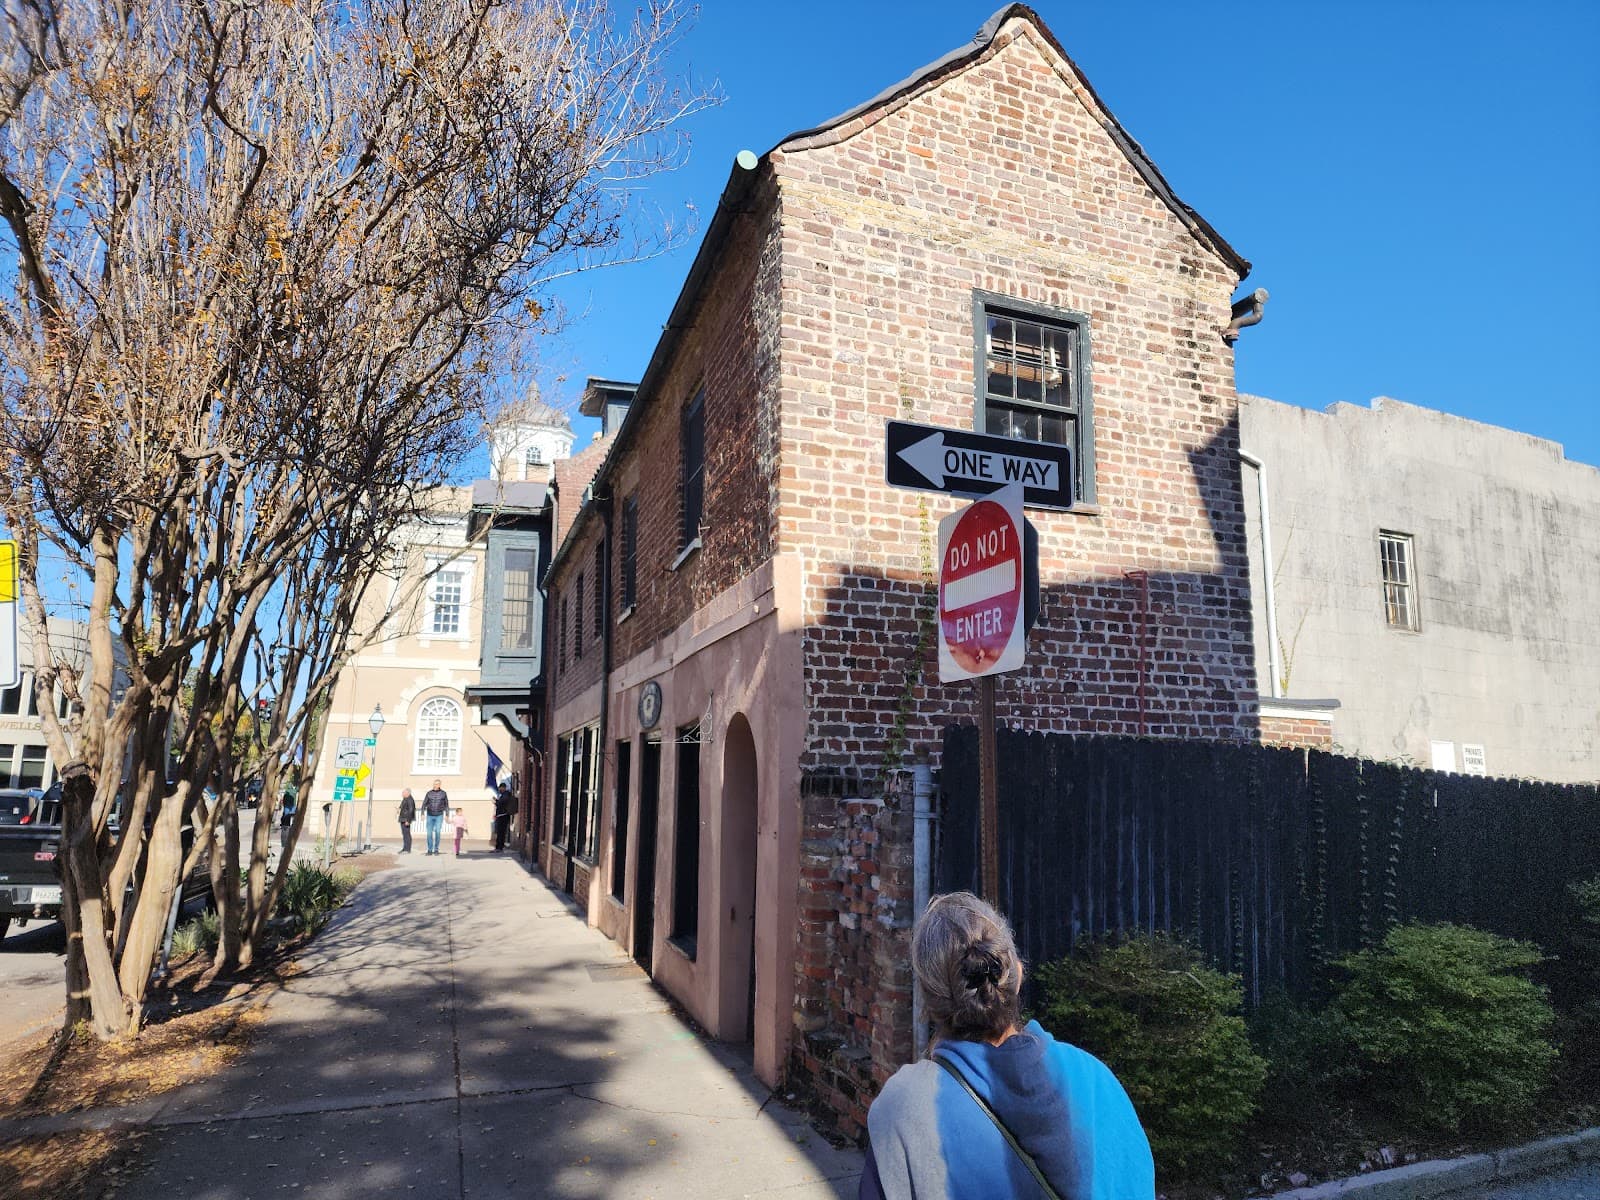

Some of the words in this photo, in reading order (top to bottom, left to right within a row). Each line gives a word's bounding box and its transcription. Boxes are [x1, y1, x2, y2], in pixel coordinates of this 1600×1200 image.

[944, 449, 993, 479] ONE
[1003, 458, 1052, 486] WAY
[950, 542, 970, 571] DO
[976, 525, 1009, 561] NOT
[956, 607, 1002, 643] ENTER
[341, 739, 362, 747] STOP
[344, 760, 359, 768] RED
